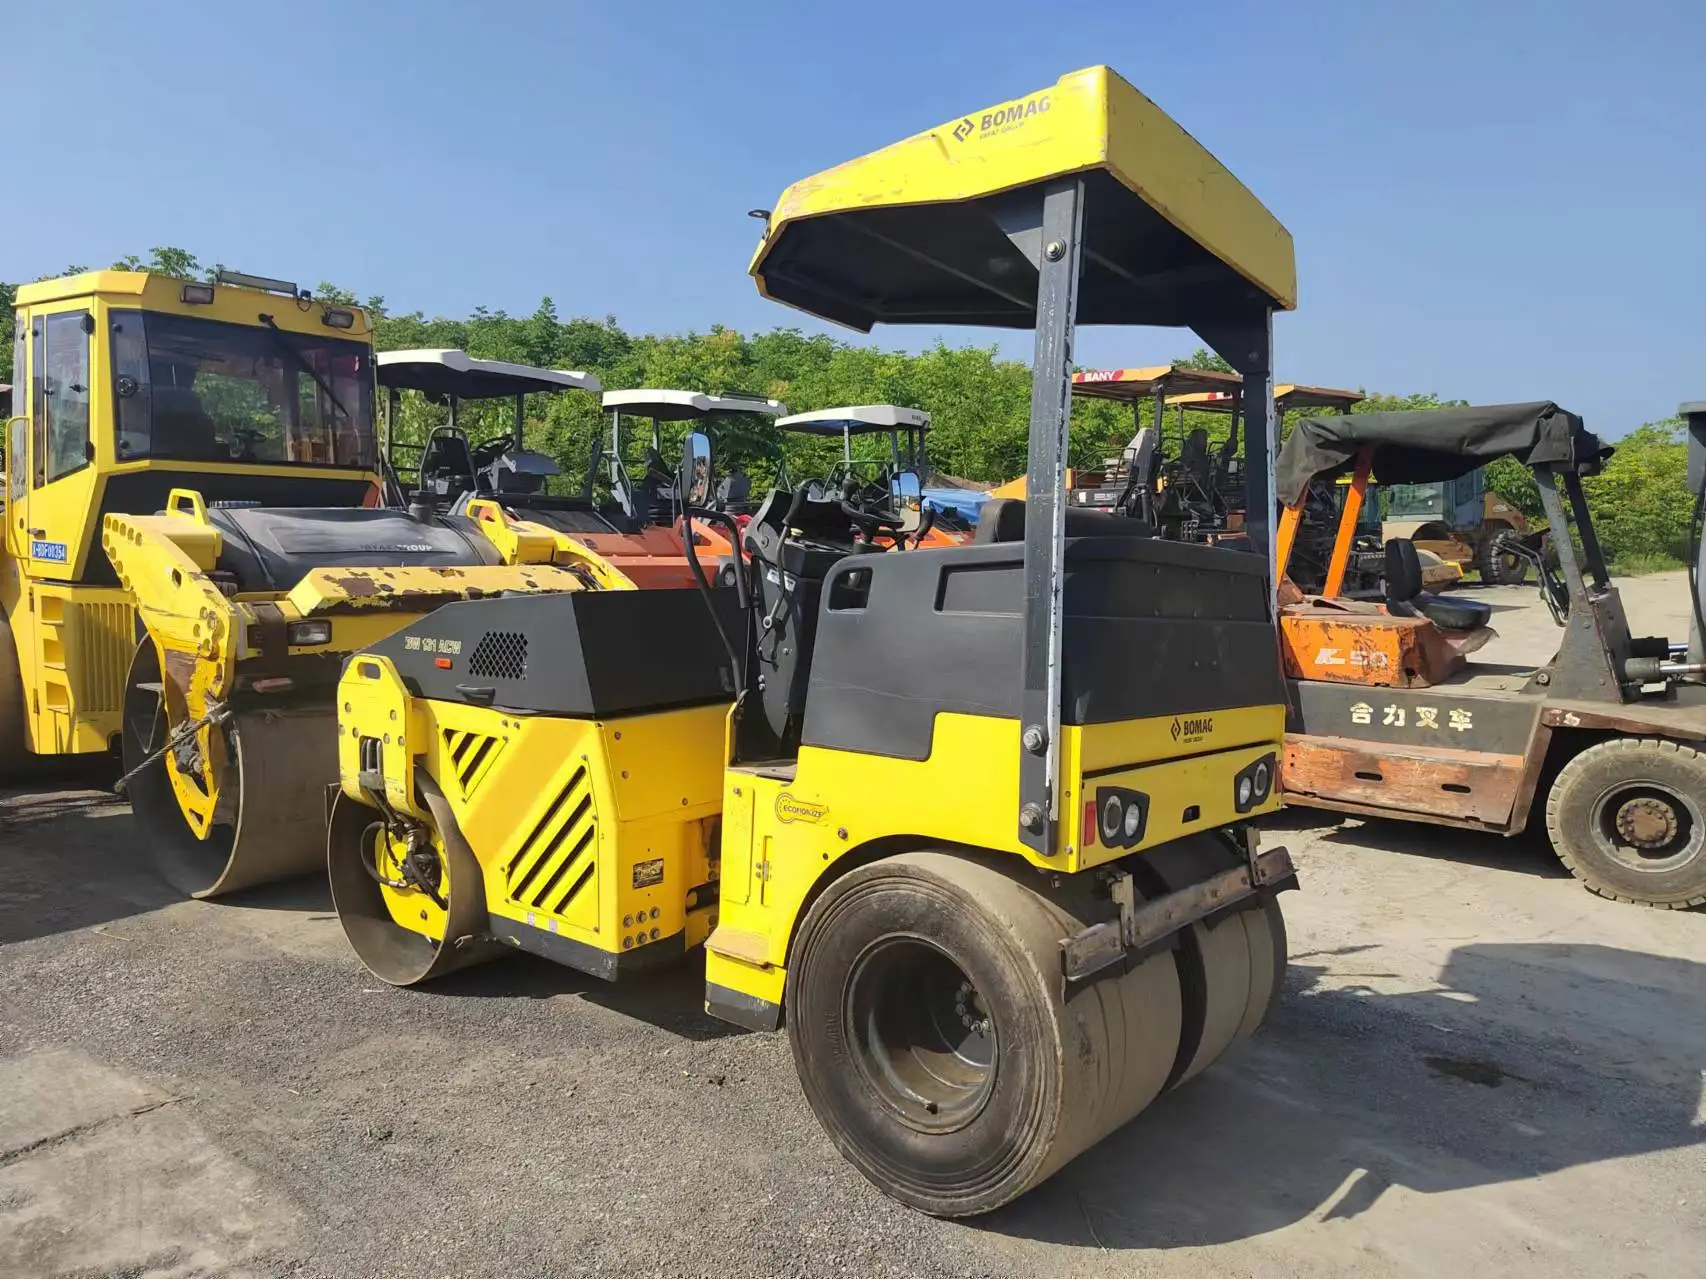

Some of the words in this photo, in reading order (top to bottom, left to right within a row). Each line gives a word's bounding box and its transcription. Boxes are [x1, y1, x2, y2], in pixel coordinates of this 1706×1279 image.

[981, 95, 1050, 131] BOMAG
[1085, 370, 1115, 382] SANY
[1184, 718, 1213, 736] BOMAG
[1350, 701, 1473, 732] 合力叉车
